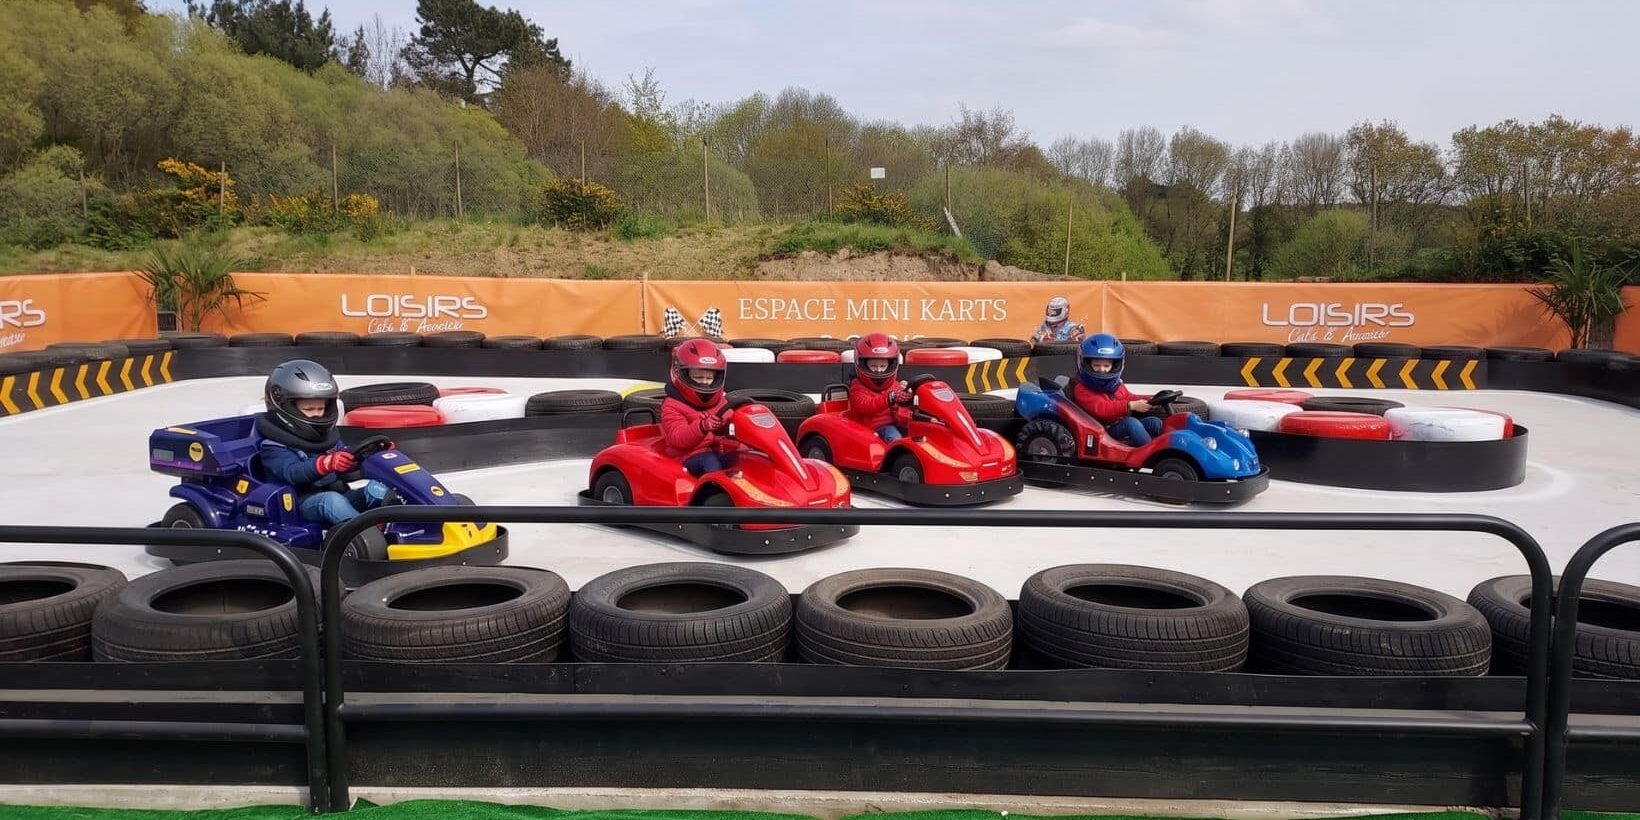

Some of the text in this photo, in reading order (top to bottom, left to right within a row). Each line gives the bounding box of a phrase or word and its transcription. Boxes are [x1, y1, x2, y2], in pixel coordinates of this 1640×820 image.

[341, 293, 488, 318] LOISIRS
[738, 298, 1007, 321] ESPACE MINI KARTS
[1262, 303, 1415, 327] LOISIRS
